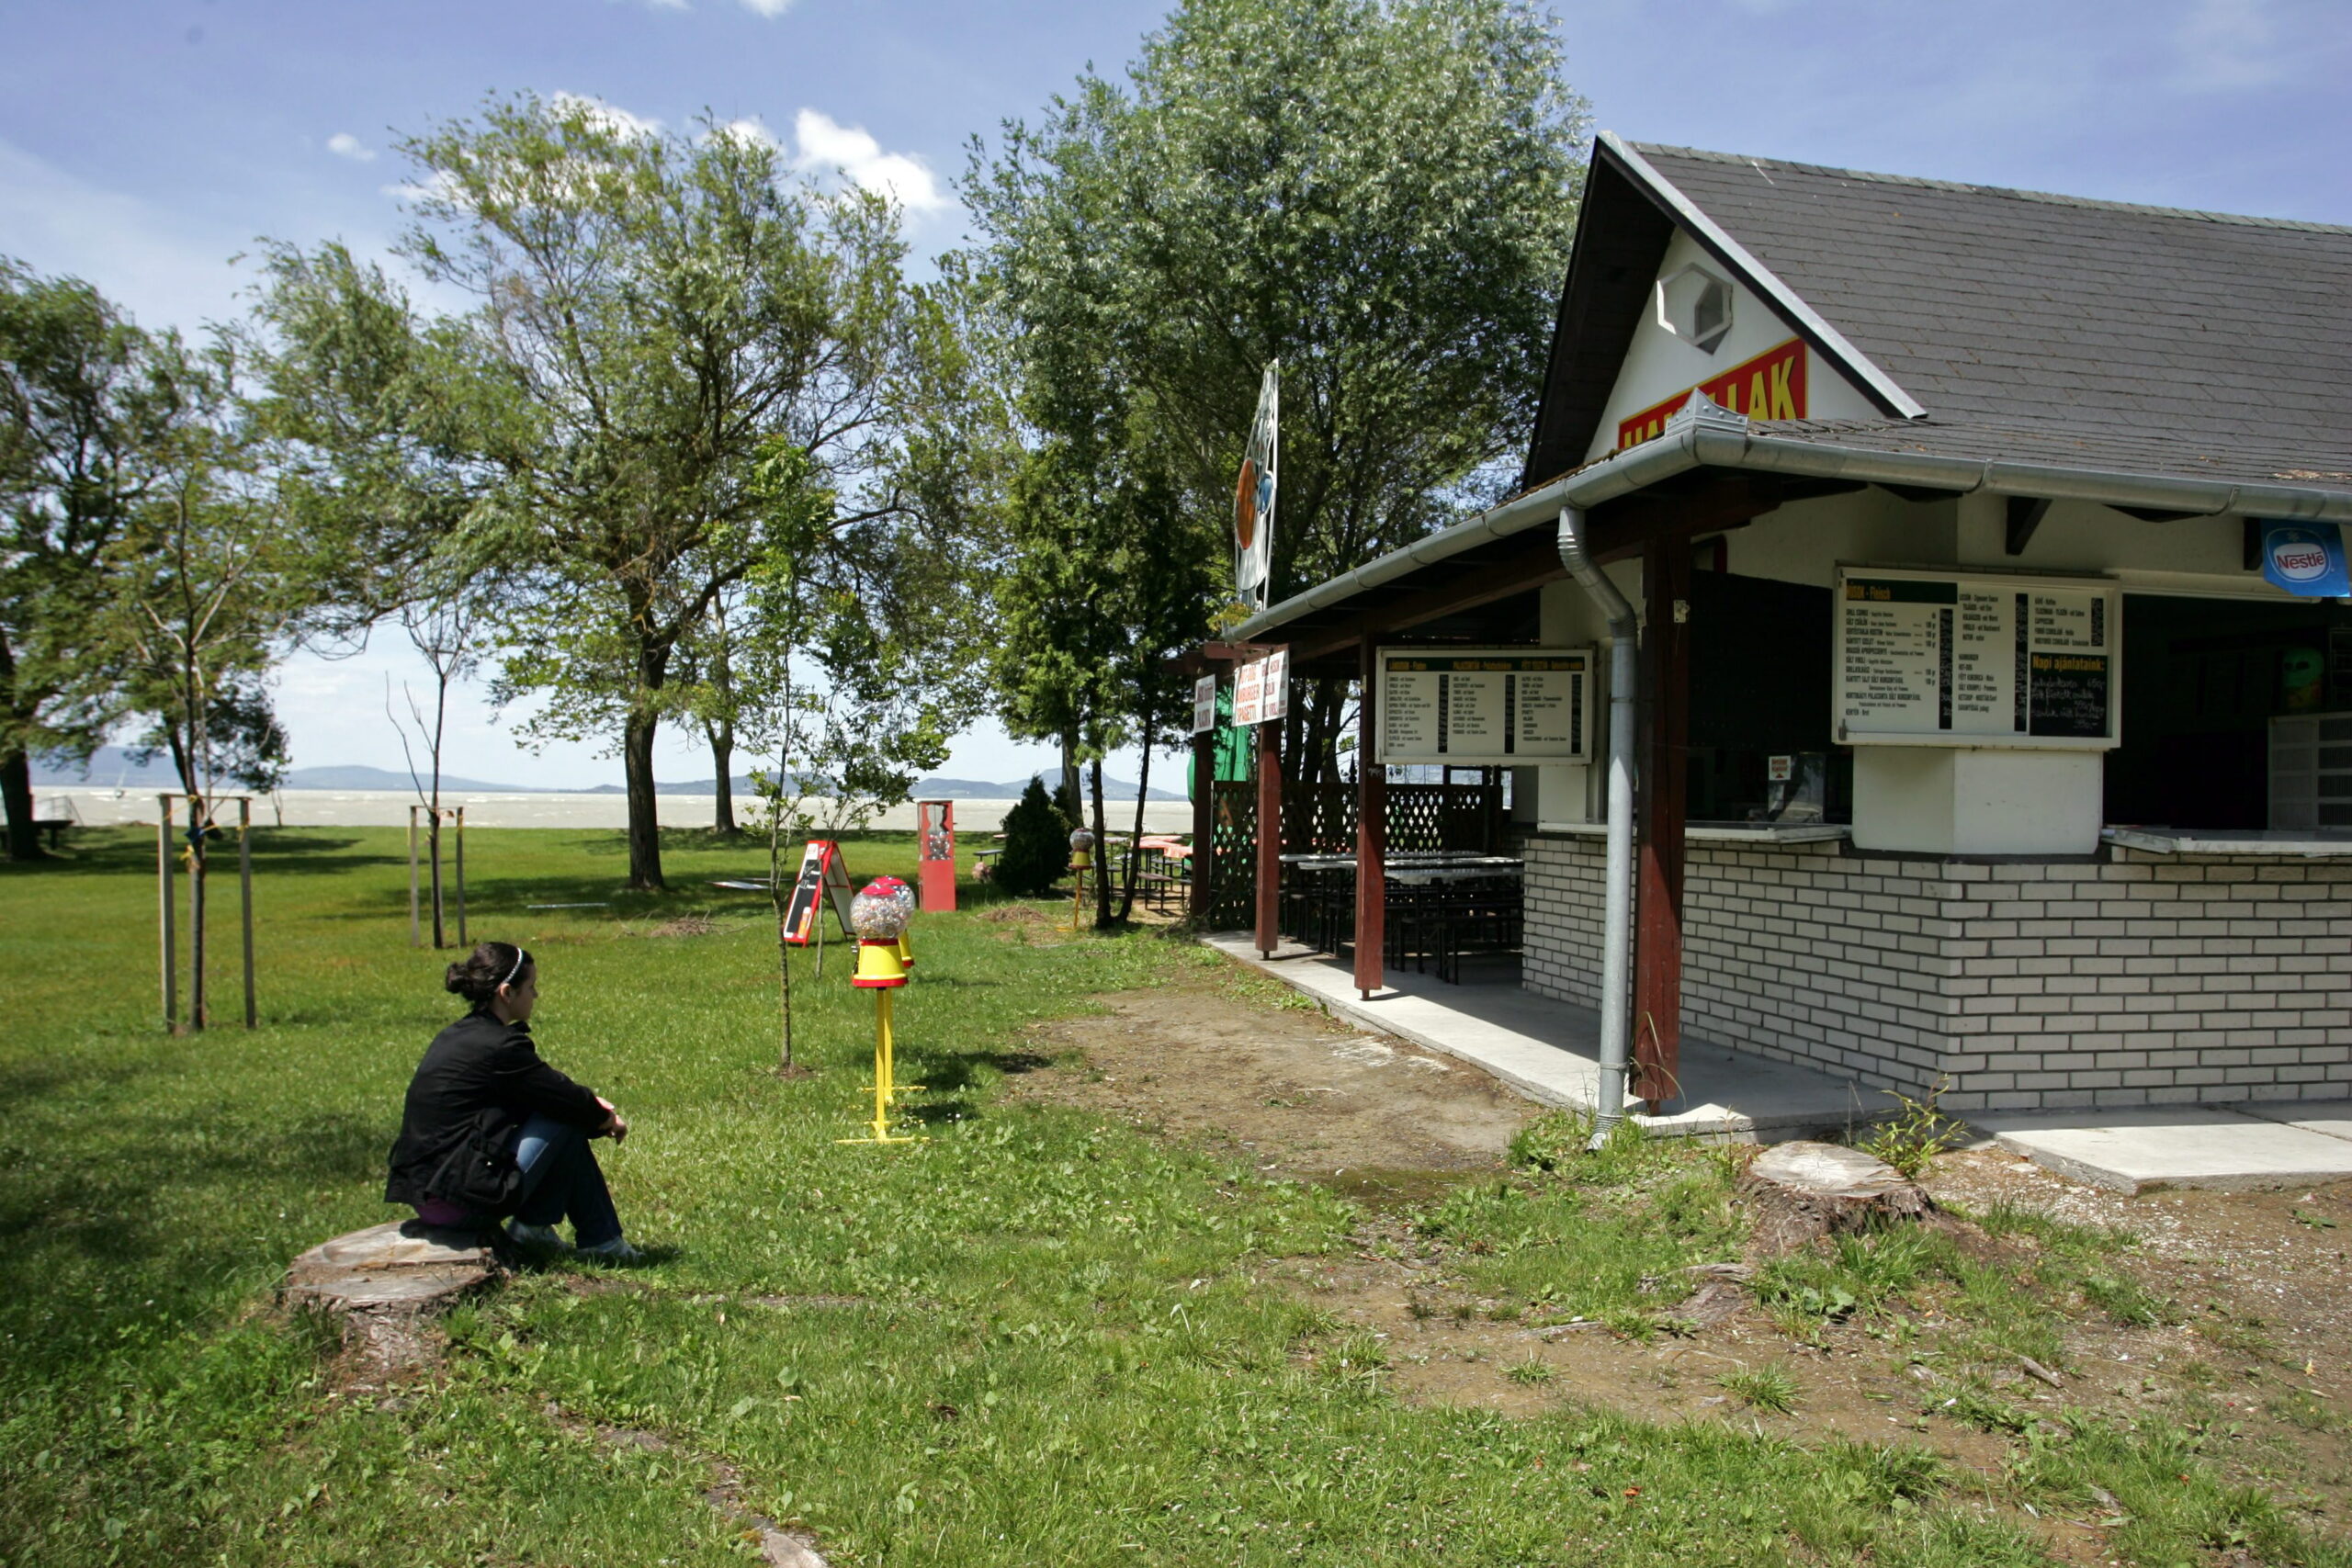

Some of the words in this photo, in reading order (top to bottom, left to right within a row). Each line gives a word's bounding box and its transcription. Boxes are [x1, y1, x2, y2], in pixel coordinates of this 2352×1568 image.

[2276, 551, 2325, 570] Nestlé
[2032, 654, 2052, 671] Napi
[2054, 655, 2106, 672] ajánlataink:
